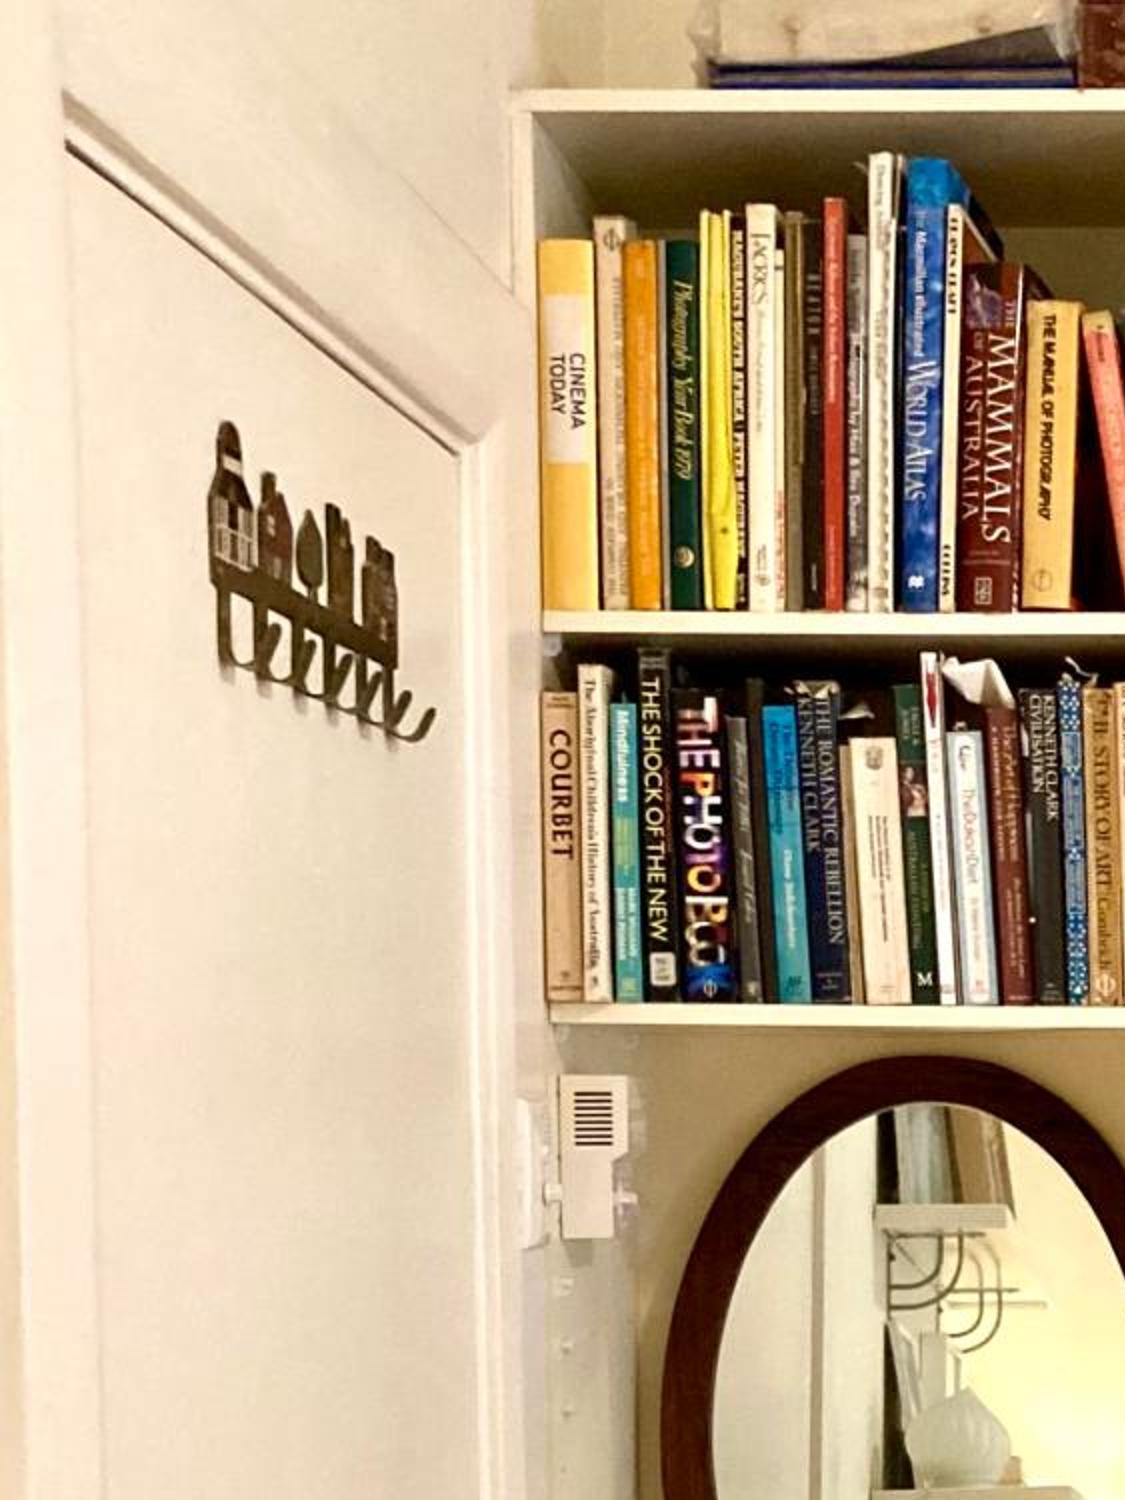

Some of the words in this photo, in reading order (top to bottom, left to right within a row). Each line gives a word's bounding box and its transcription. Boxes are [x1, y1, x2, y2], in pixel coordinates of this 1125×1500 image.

[914, 231, 928, 293] Macmillan
[673, 280, 696, 370] Photography
[1043, 314, 1058, 340] THE
[549, 352, 568, 416] TODAY
[570, 351, 588, 429] CINEMA
[673, 377, 694, 411] Year
[1040, 341, 1057, 397] MANUAL
[674, 409, 695, 447] Book
[905, 360, 940, 442] WORLD
[1040, 402, 1056, 419] OF
[962, 355, 983, 520] AUSTRALIA
[980, 334, 1016, 545] MAMMALS
[903, 443, 936, 502] ATLAS
[1037, 421, 1056, 522] PHOTOGRAPHY
[584, 679, 599, 703] The
[640, 677, 661, 722] THE
[814, 699, 834, 736] THE
[613, 709, 631, 804] Mindfulness
[676, 696, 721, 769] THE
[797, 697, 817, 789] KENNETH
[1029, 694, 1046, 793] CIVILISATION
[1043, 694, 1060, 767] KENNETH
[549, 729, 575, 861] COURBET
[643, 724, 663, 803] SHOCK
[817, 740, 841, 843] ROMANTIC
[1093, 746, 1112, 812] STORY
[644, 807, 664, 837] OF
[802, 792, 822, 853] CLARK
[1044, 769, 1061, 822] CLARK
[647, 838, 666, 884] THE
[1095, 817, 1113, 844] OF
[588, 891, 603, 905] of
[823, 848, 847, 945] REBELLION
[1095, 847, 1113, 888] ART
[649, 888, 669, 942] NEW
[1097, 897, 1114, 971] Gombrich
